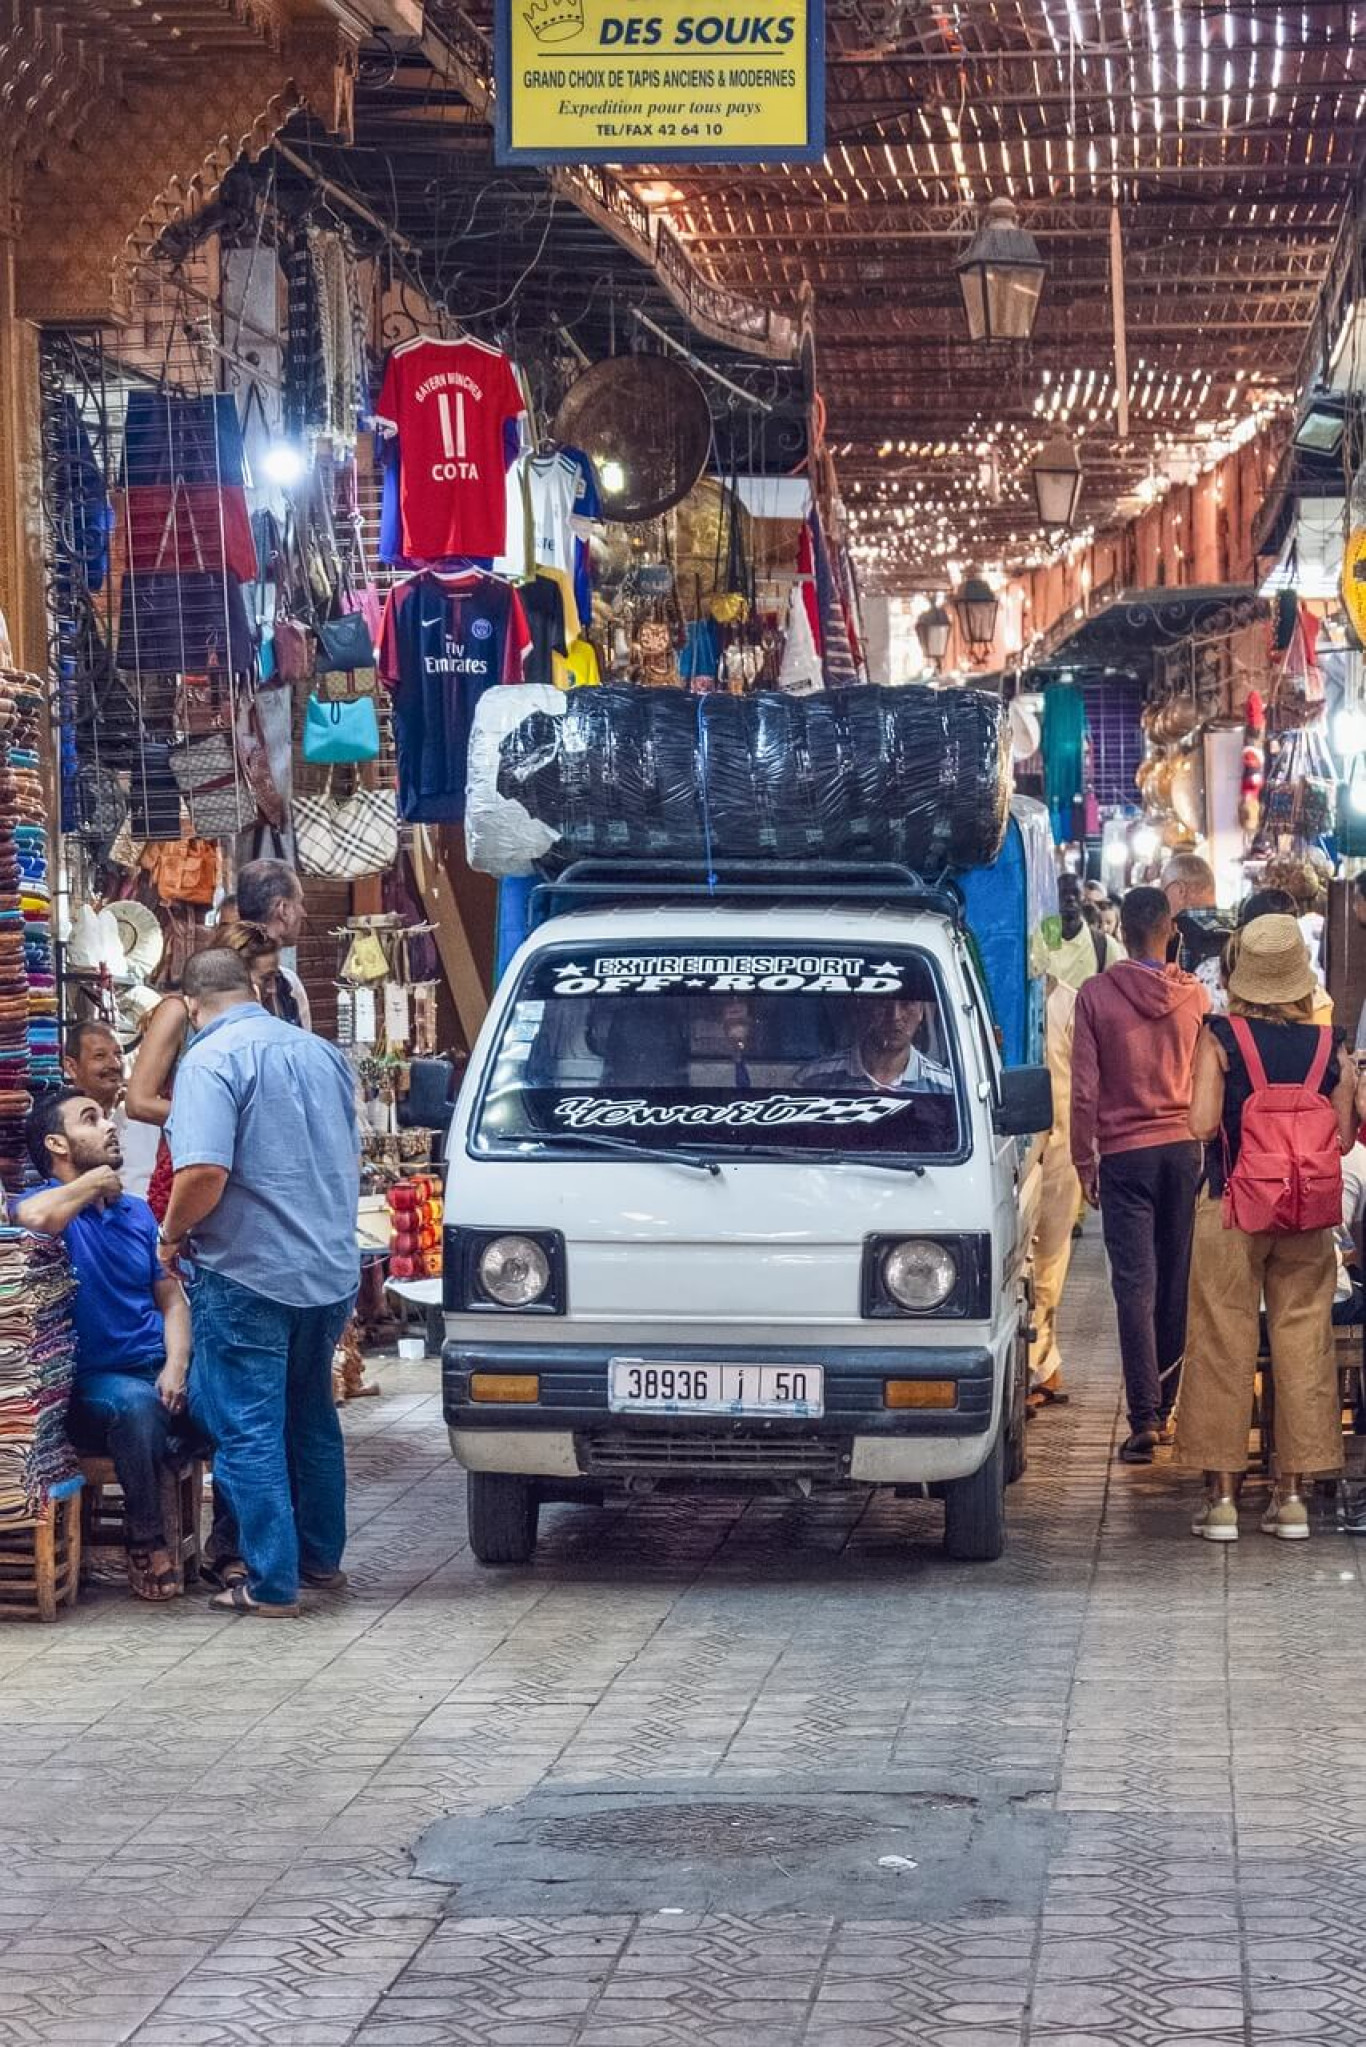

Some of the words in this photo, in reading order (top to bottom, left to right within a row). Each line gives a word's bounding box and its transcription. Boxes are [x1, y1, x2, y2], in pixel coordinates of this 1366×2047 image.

[599, 17, 663, 46] DES
[674, 16, 796, 46] SOUKS
[523, 70, 565, 88] GRAND
[569, 70, 605, 88] CHOIX
[608, 70, 623, 87] DE
[627, 70, 660, 87] TAPIS
[663, 70, 714, 87] ANCIENS
[717, 70, 726, 87] &
[729, 69, 796, 87] MODERNES
[558, 100, 642, 116] Expedition
[647, 103, 684, 117] pour
[690, 101, 722, 114] tous
[726, 103, 761, 117] pays
[596, 124, 653, 137] TEL/FAX
[658, 124, 676, 136] 42
[681, 124, 698, 136] 64
[706, 124, 722, 136] 10
[415, 373, 447, 402] BAYERN
[437, 391, 466, 459] 11
[431, 463, 479, 481] COTA
[423, 655, 488, 674] Emirates
[594, 956, 865, 976] EXTREMESPORT
[553, 976, 682, 995] OFF
[709, 974, 903, 993] ROAD
[628, 1368, 708, 1401] 38936
[775, 1372, 807, 1402] 50
